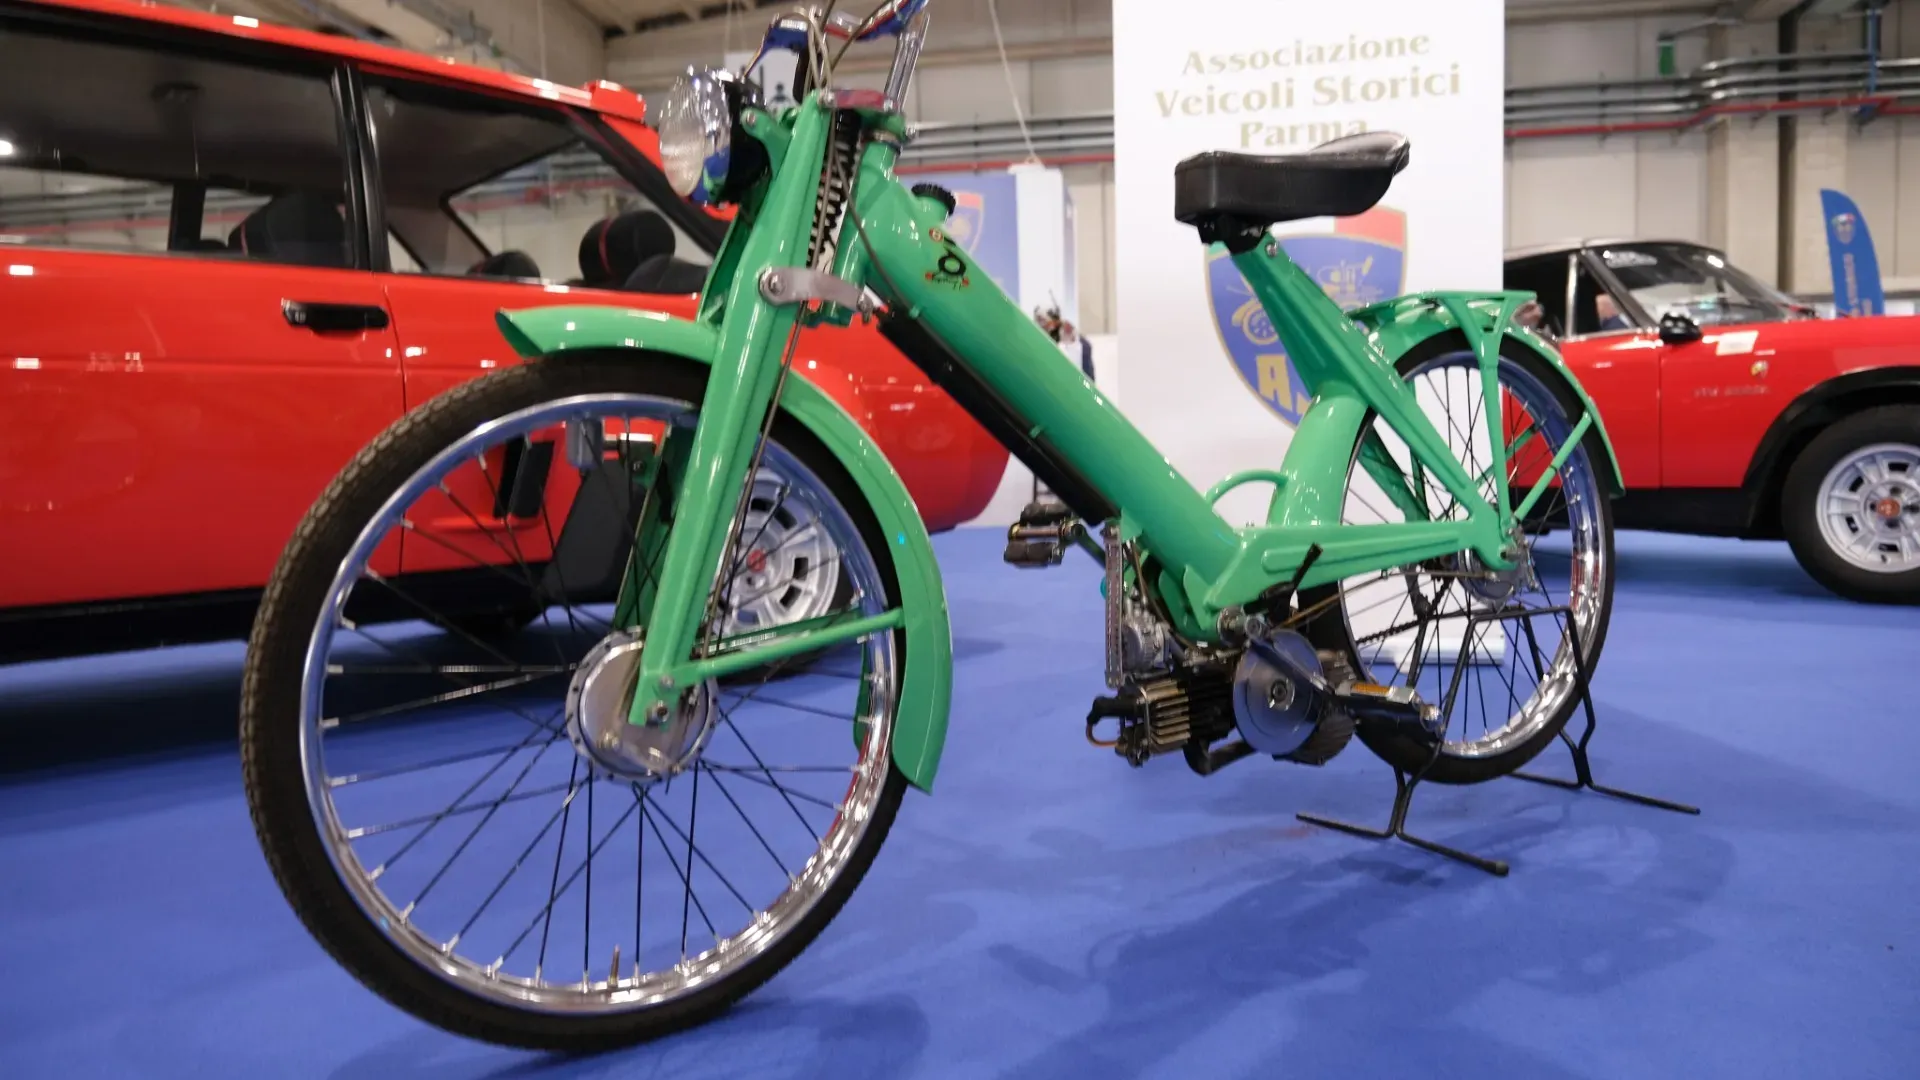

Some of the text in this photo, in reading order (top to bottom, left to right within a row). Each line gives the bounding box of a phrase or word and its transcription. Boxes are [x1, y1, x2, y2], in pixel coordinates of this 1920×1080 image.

[1182, 33, 1430, 76] Associazione
[1154, 63, 1461, 118] Veicoli Storici
